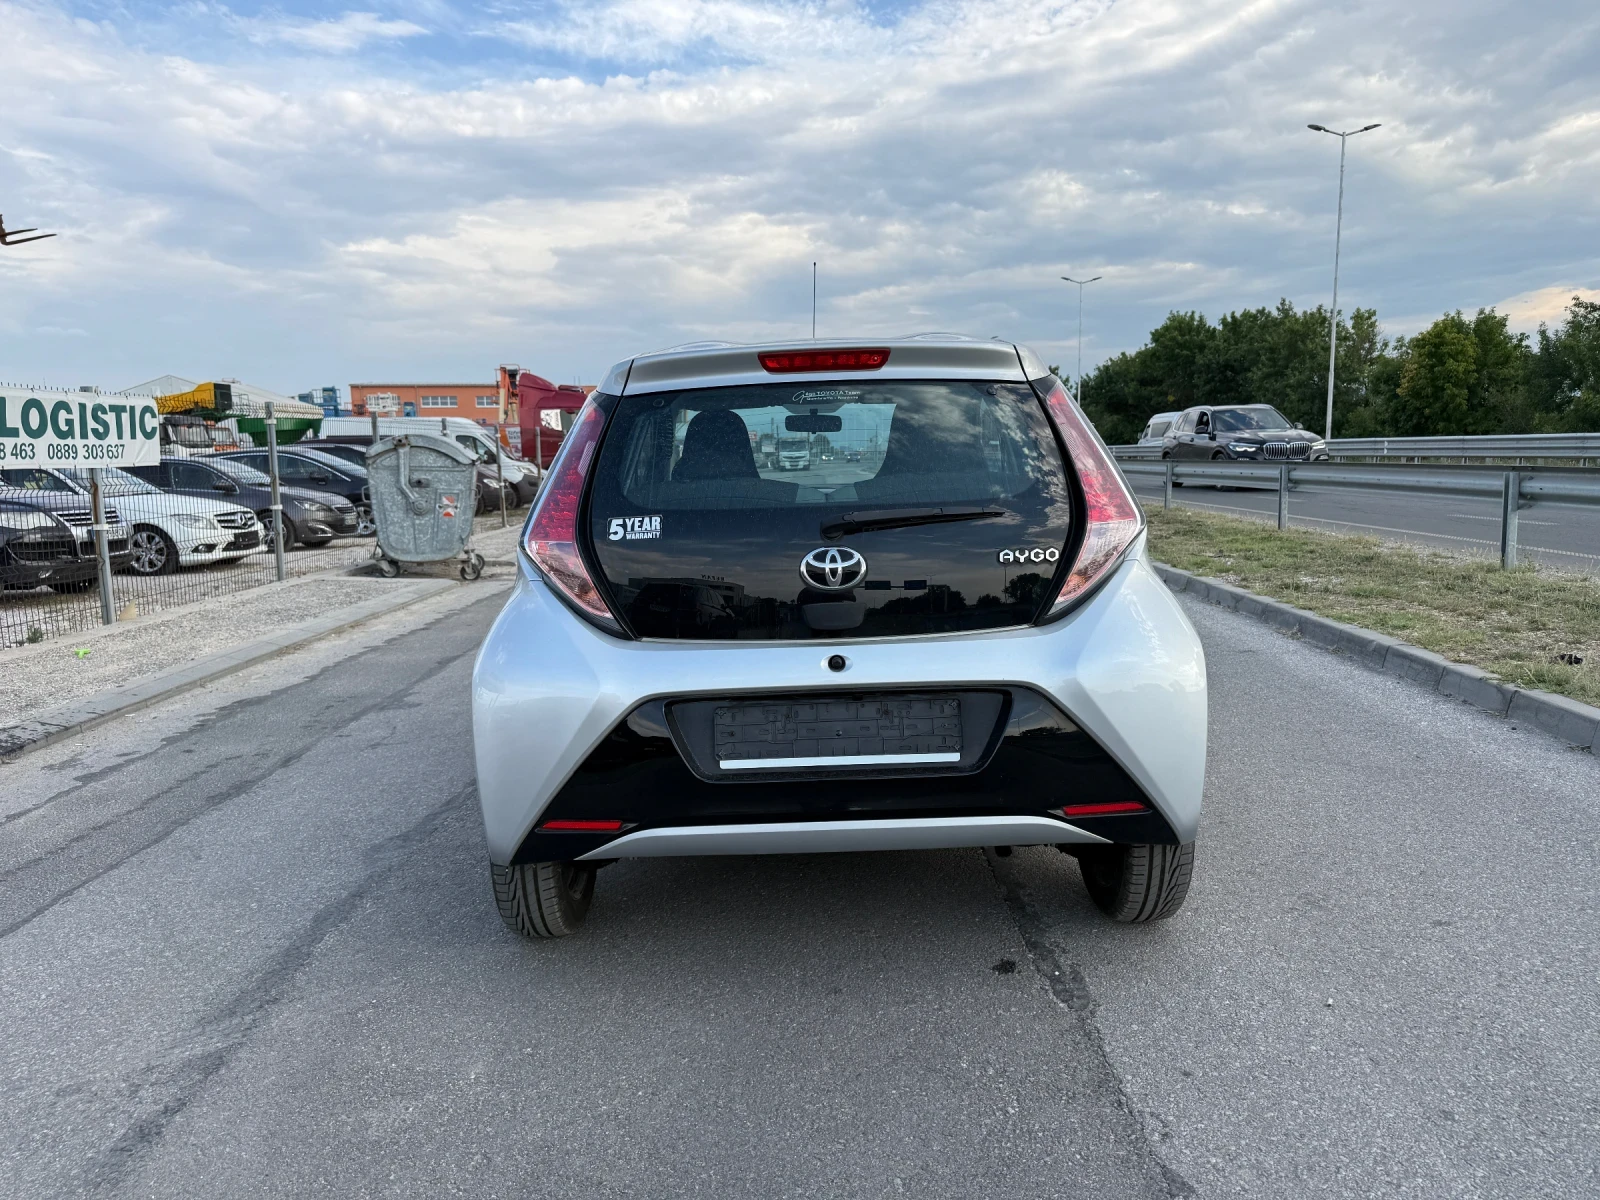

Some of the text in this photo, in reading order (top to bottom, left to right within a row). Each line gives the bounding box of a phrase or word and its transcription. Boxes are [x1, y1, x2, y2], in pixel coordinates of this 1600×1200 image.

[0, 396, 158, 440] LOGISTIC
[10, 442, 36, 460] 463
[47, 443, 78, 460] 0889
[82, 443, 105, 460] 303
[106, 443, 126, 460] 637
[608, 516, 661, 541] 5 YEAR
[625, 531, 661, 540] WARRANTY
[999, 547, 1060, 563] AYGO
